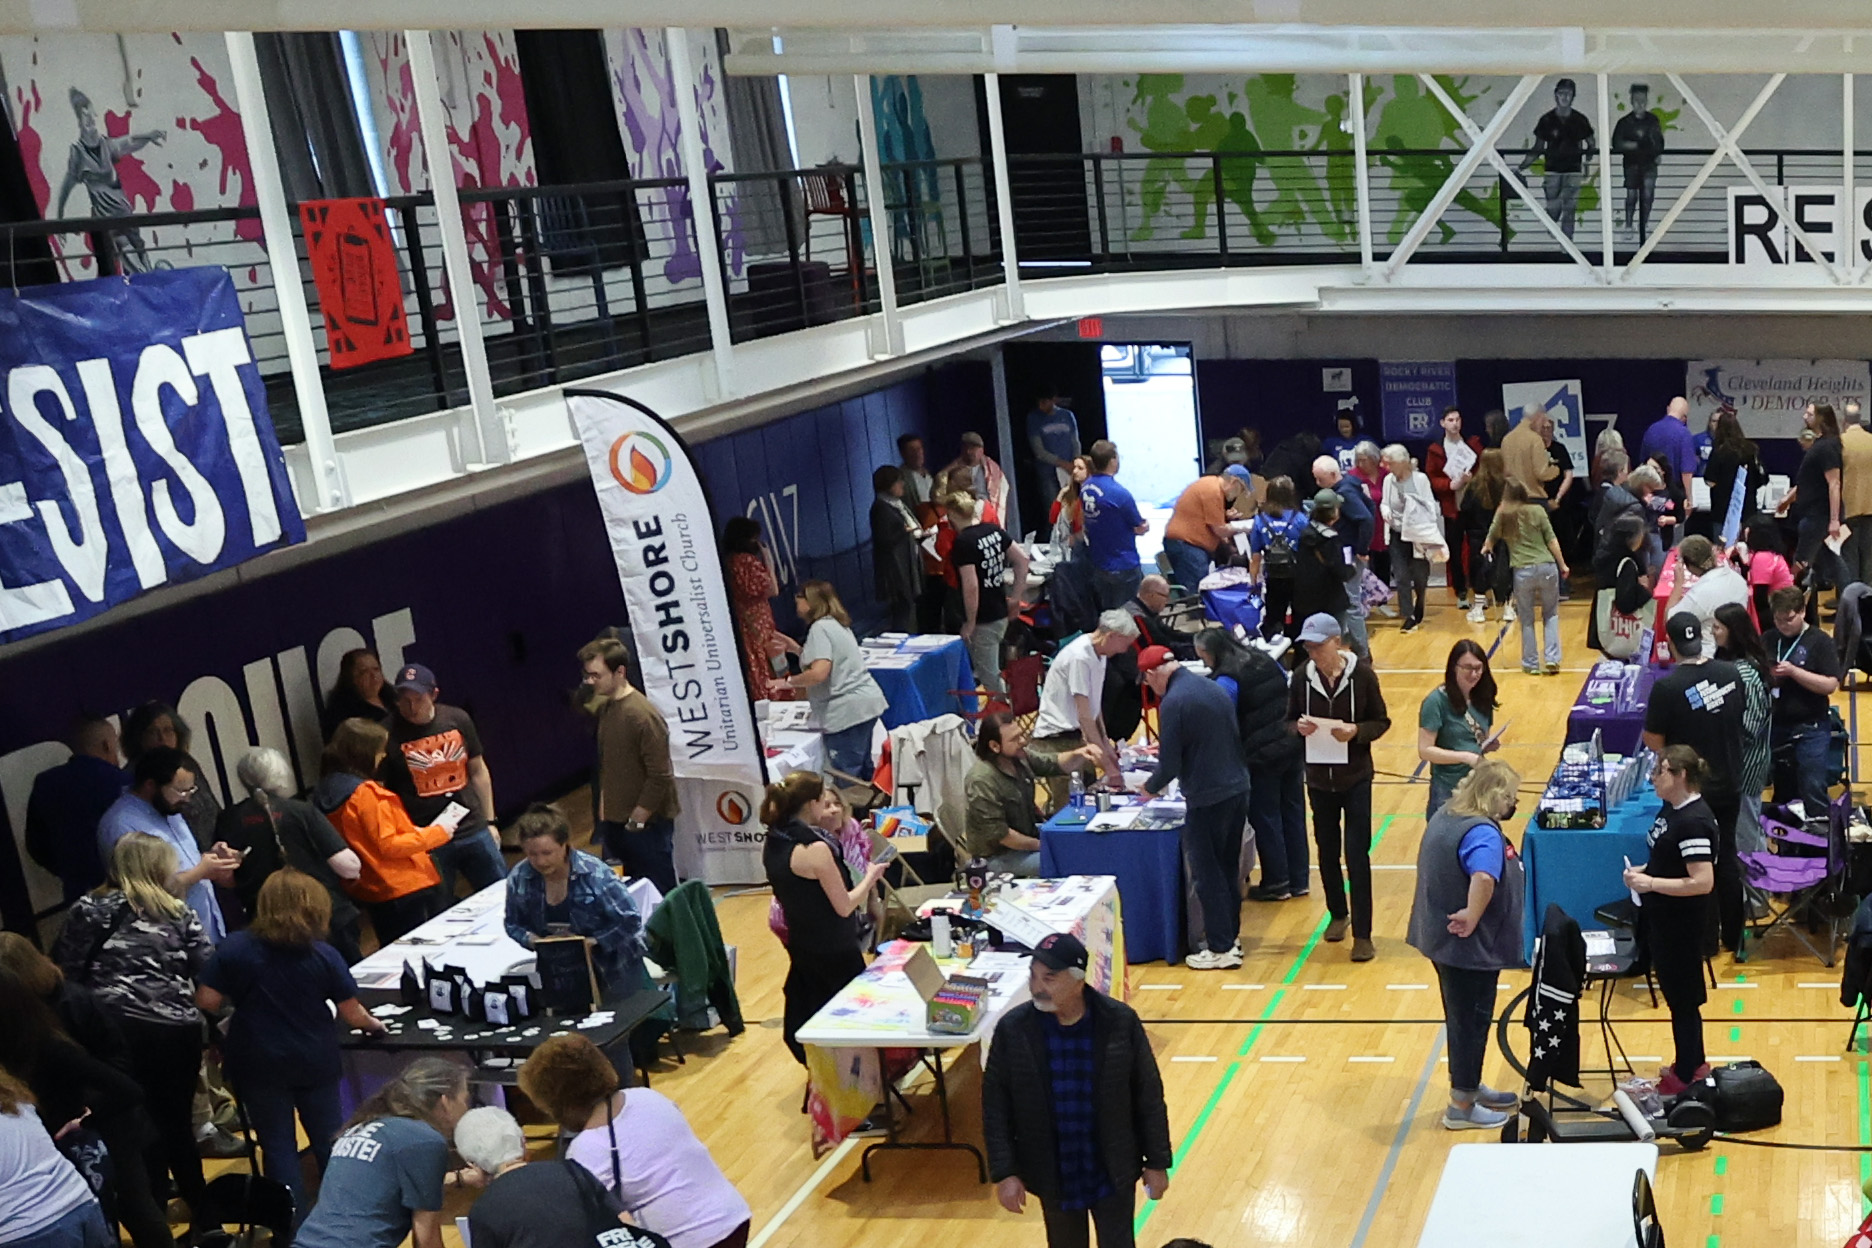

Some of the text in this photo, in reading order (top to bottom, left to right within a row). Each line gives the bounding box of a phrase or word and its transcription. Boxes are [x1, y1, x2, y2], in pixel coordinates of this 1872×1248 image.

[1420, 366, 1450, 377] RIVER
[1385, 381, 1451, 392] DEMOCRATIC
[1728, 375, 1865, 393] Cleveland Heights
[1406, 397, 1432, 406] CLUB
[671, 512, 739, 752] Unitarian Universalist Church
